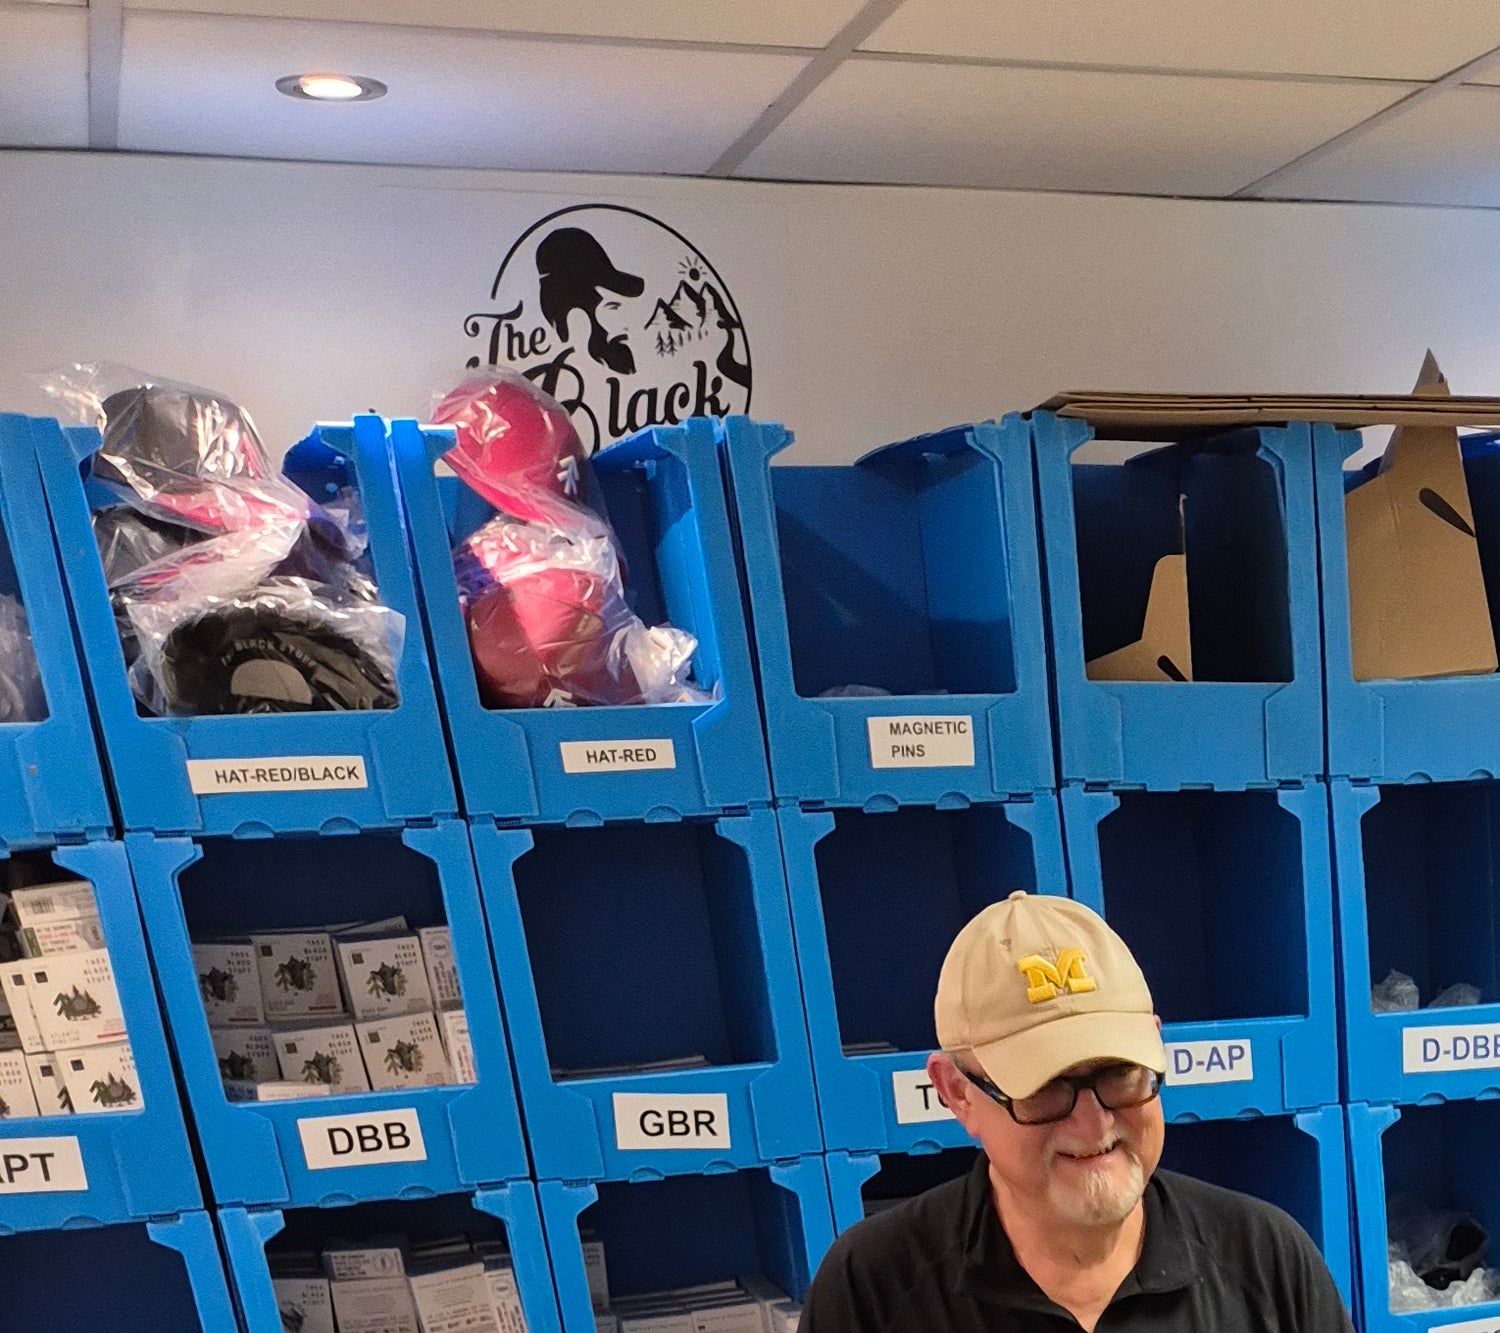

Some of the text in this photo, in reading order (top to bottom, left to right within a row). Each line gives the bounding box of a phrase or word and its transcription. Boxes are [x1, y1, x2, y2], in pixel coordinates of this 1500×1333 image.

[464, 300, 551, 365] The
[889, 720, 967, 736] MAGNETIC
[586, 748, 656, 764] HAT-RED
[892, 744, 925, 758] PINS
[215, 766, 360, 784] HAT-RED/BLACK
[1017, 947, 1096, 1003] M
[1174, 1045, 1246, 1075] D-AP
[639, 1109, 718, 1138] GBR
[327, 1121, 412, 1156] DBB
[0, 1152, 54, 1184] PT
